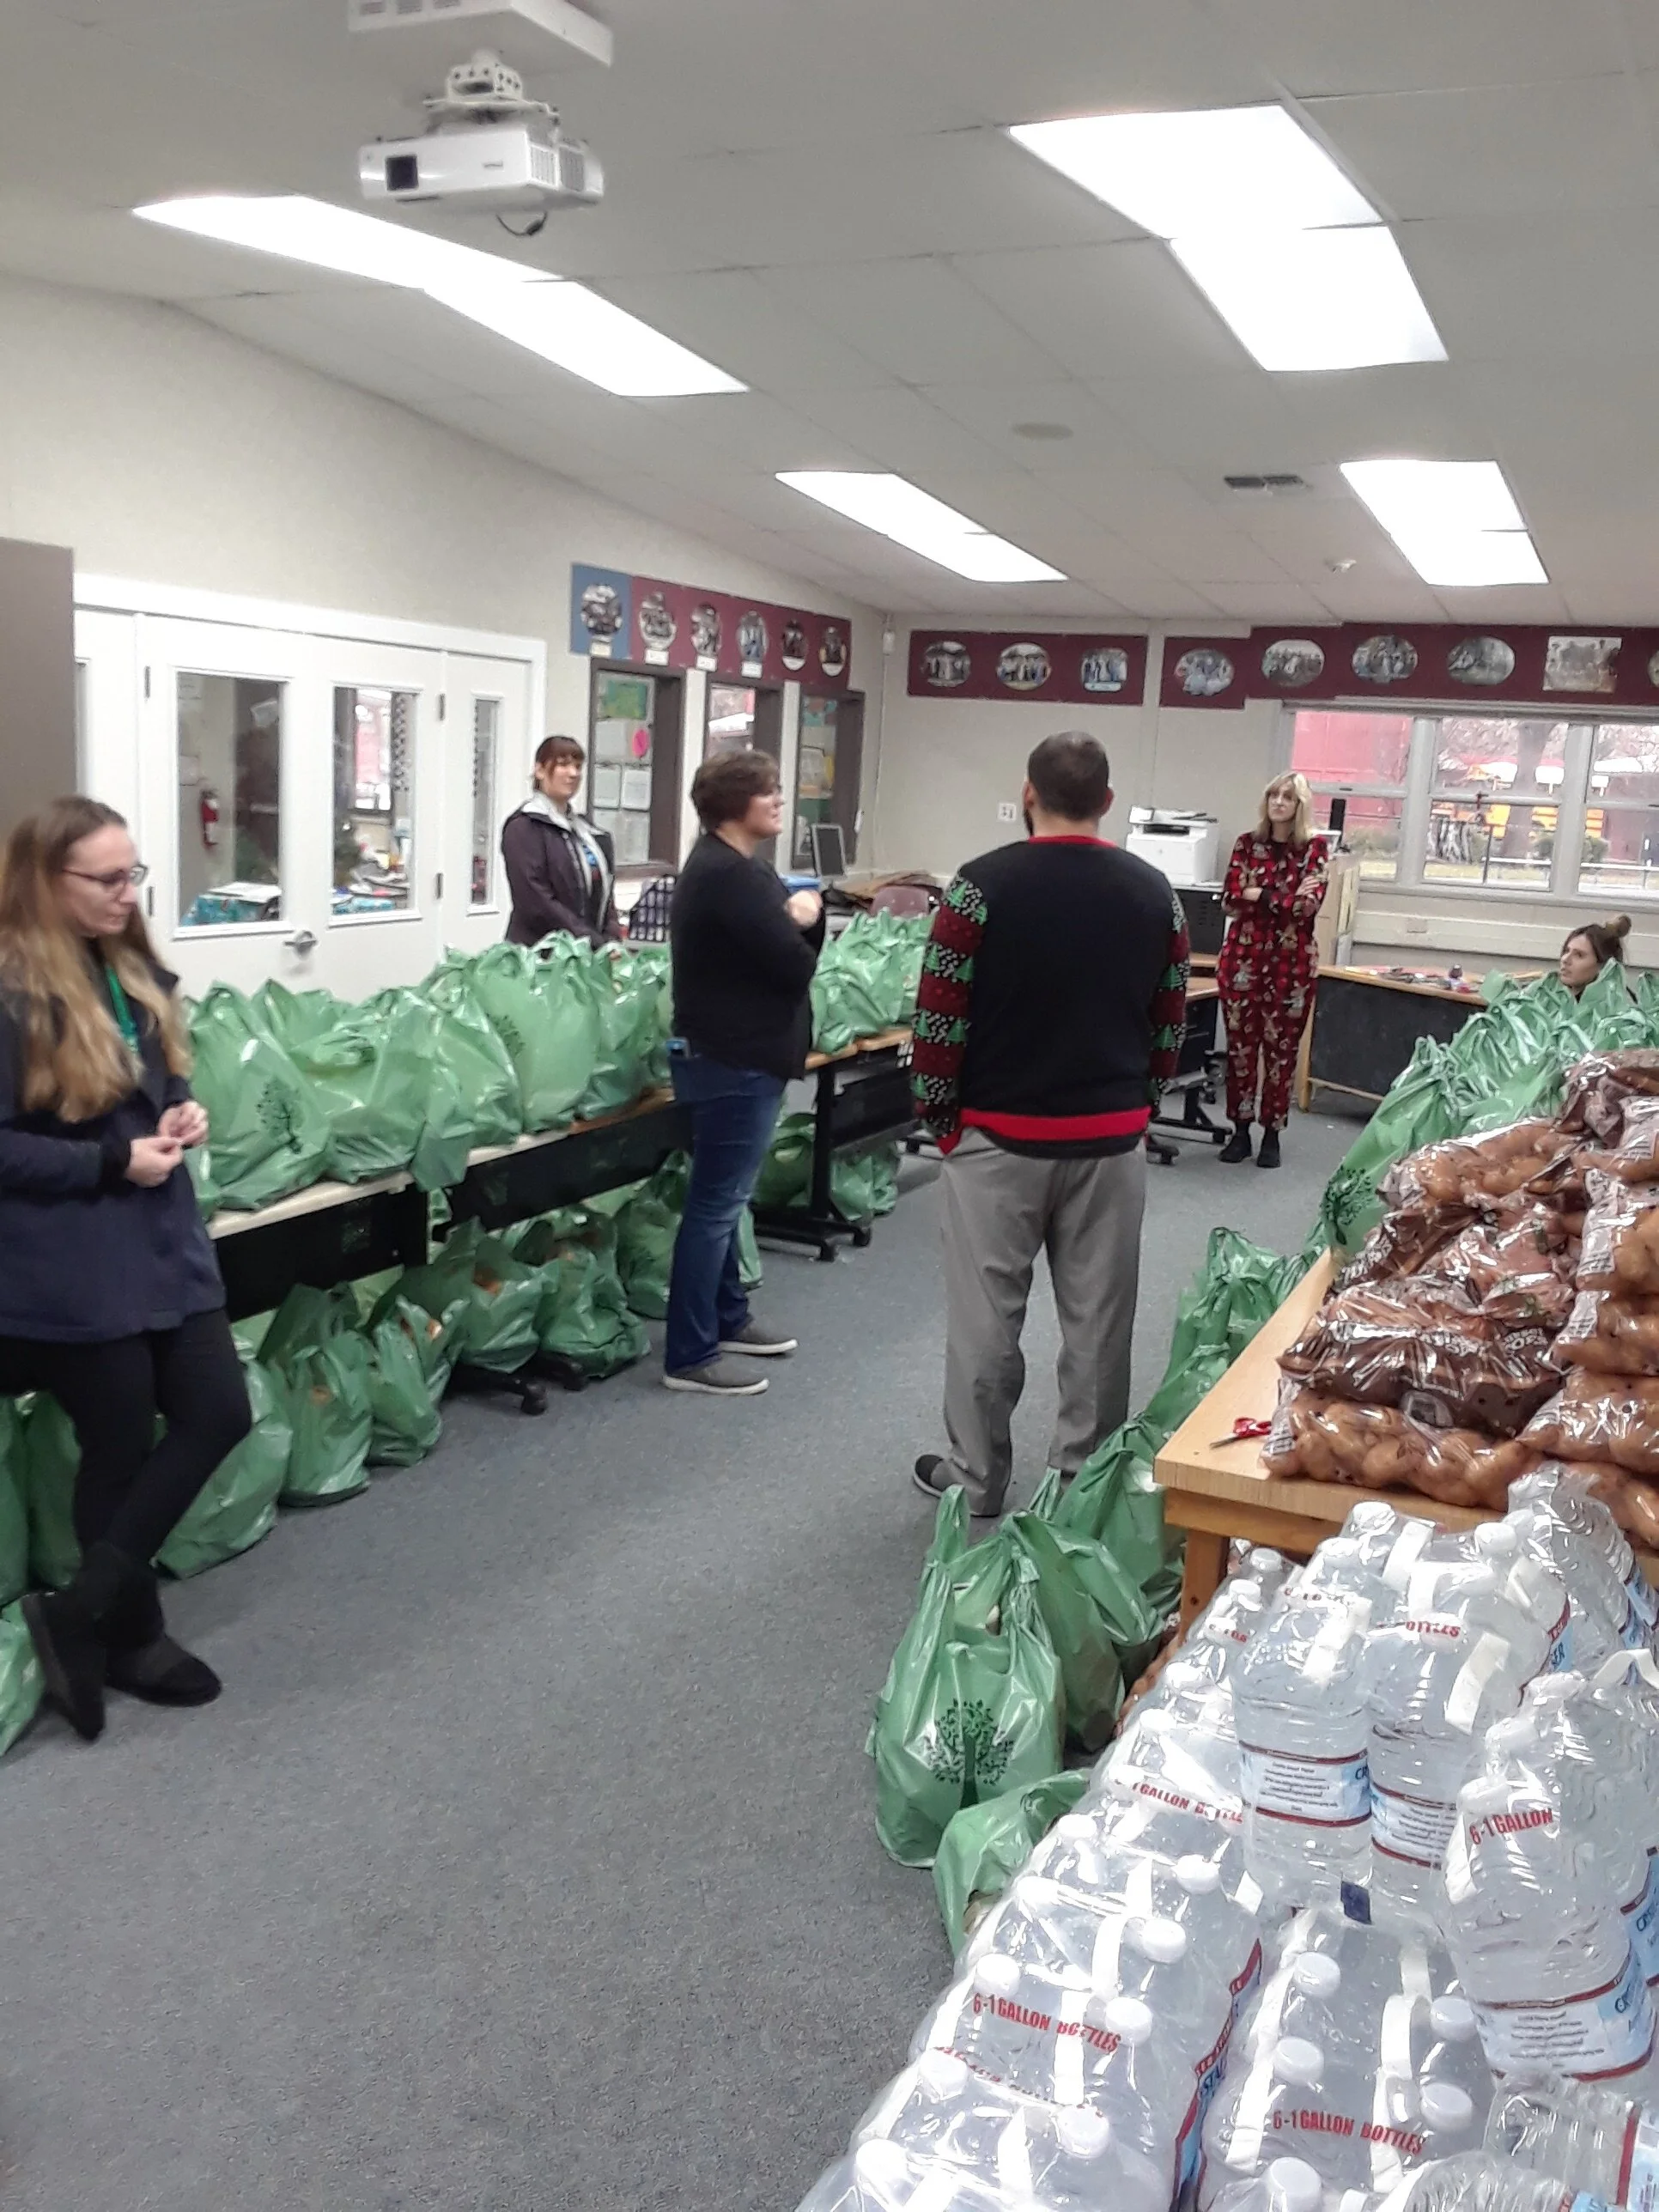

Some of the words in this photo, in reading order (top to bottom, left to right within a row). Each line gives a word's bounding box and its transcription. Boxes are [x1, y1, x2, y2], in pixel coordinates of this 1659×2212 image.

[1139, 1784, 1190, 1810] GALLON
[1492, 1808, 1553, 1835] GALLON
[973, 1992, 996, 2015] 6-1
[997, 1996, 1052, 2031] GALLON
[1273, 2109, 1297, 2130] 6-1
[1299, 2109, 1355, 2137] GALLON
[1359, 2121, 1428, 2154] BOTTLES
